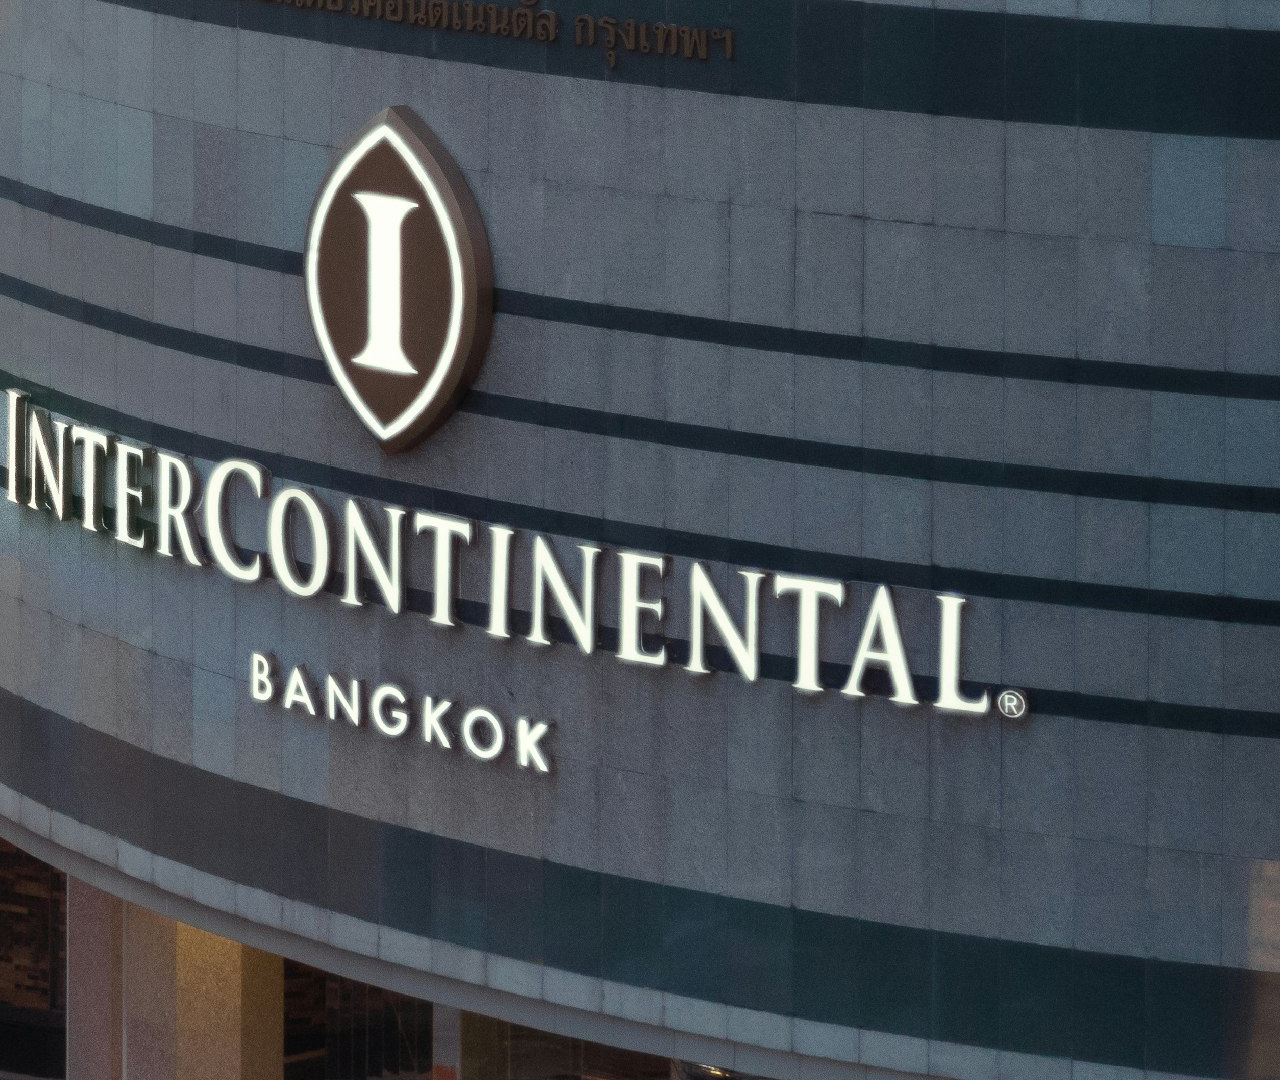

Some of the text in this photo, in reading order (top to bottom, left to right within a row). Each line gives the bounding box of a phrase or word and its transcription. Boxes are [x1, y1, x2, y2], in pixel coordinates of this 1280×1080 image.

[575, 11, 734, 68] กรุงเทพฯ
[251, 651, 552, 774] BANGKOK
